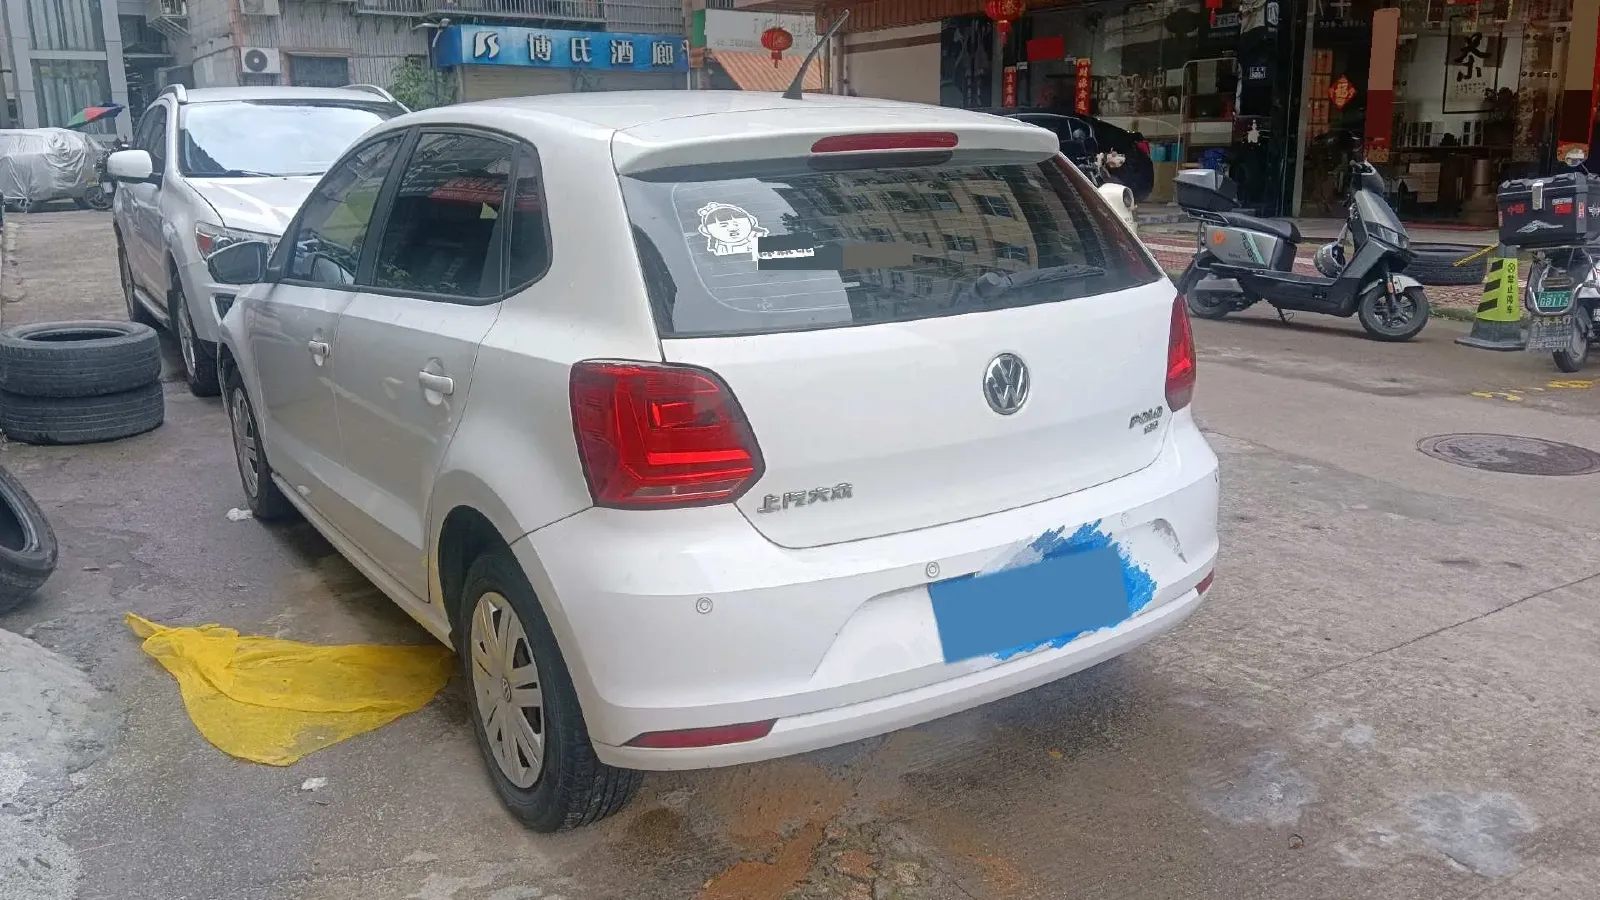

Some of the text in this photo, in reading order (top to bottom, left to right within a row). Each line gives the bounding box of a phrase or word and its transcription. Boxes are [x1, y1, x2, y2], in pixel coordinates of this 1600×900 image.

[528, 33, 673, 65] 博氏酒廊
[1506, 275, 1515, 314] 禁止停车
[757, 482, 853, 514] 上汽大众
